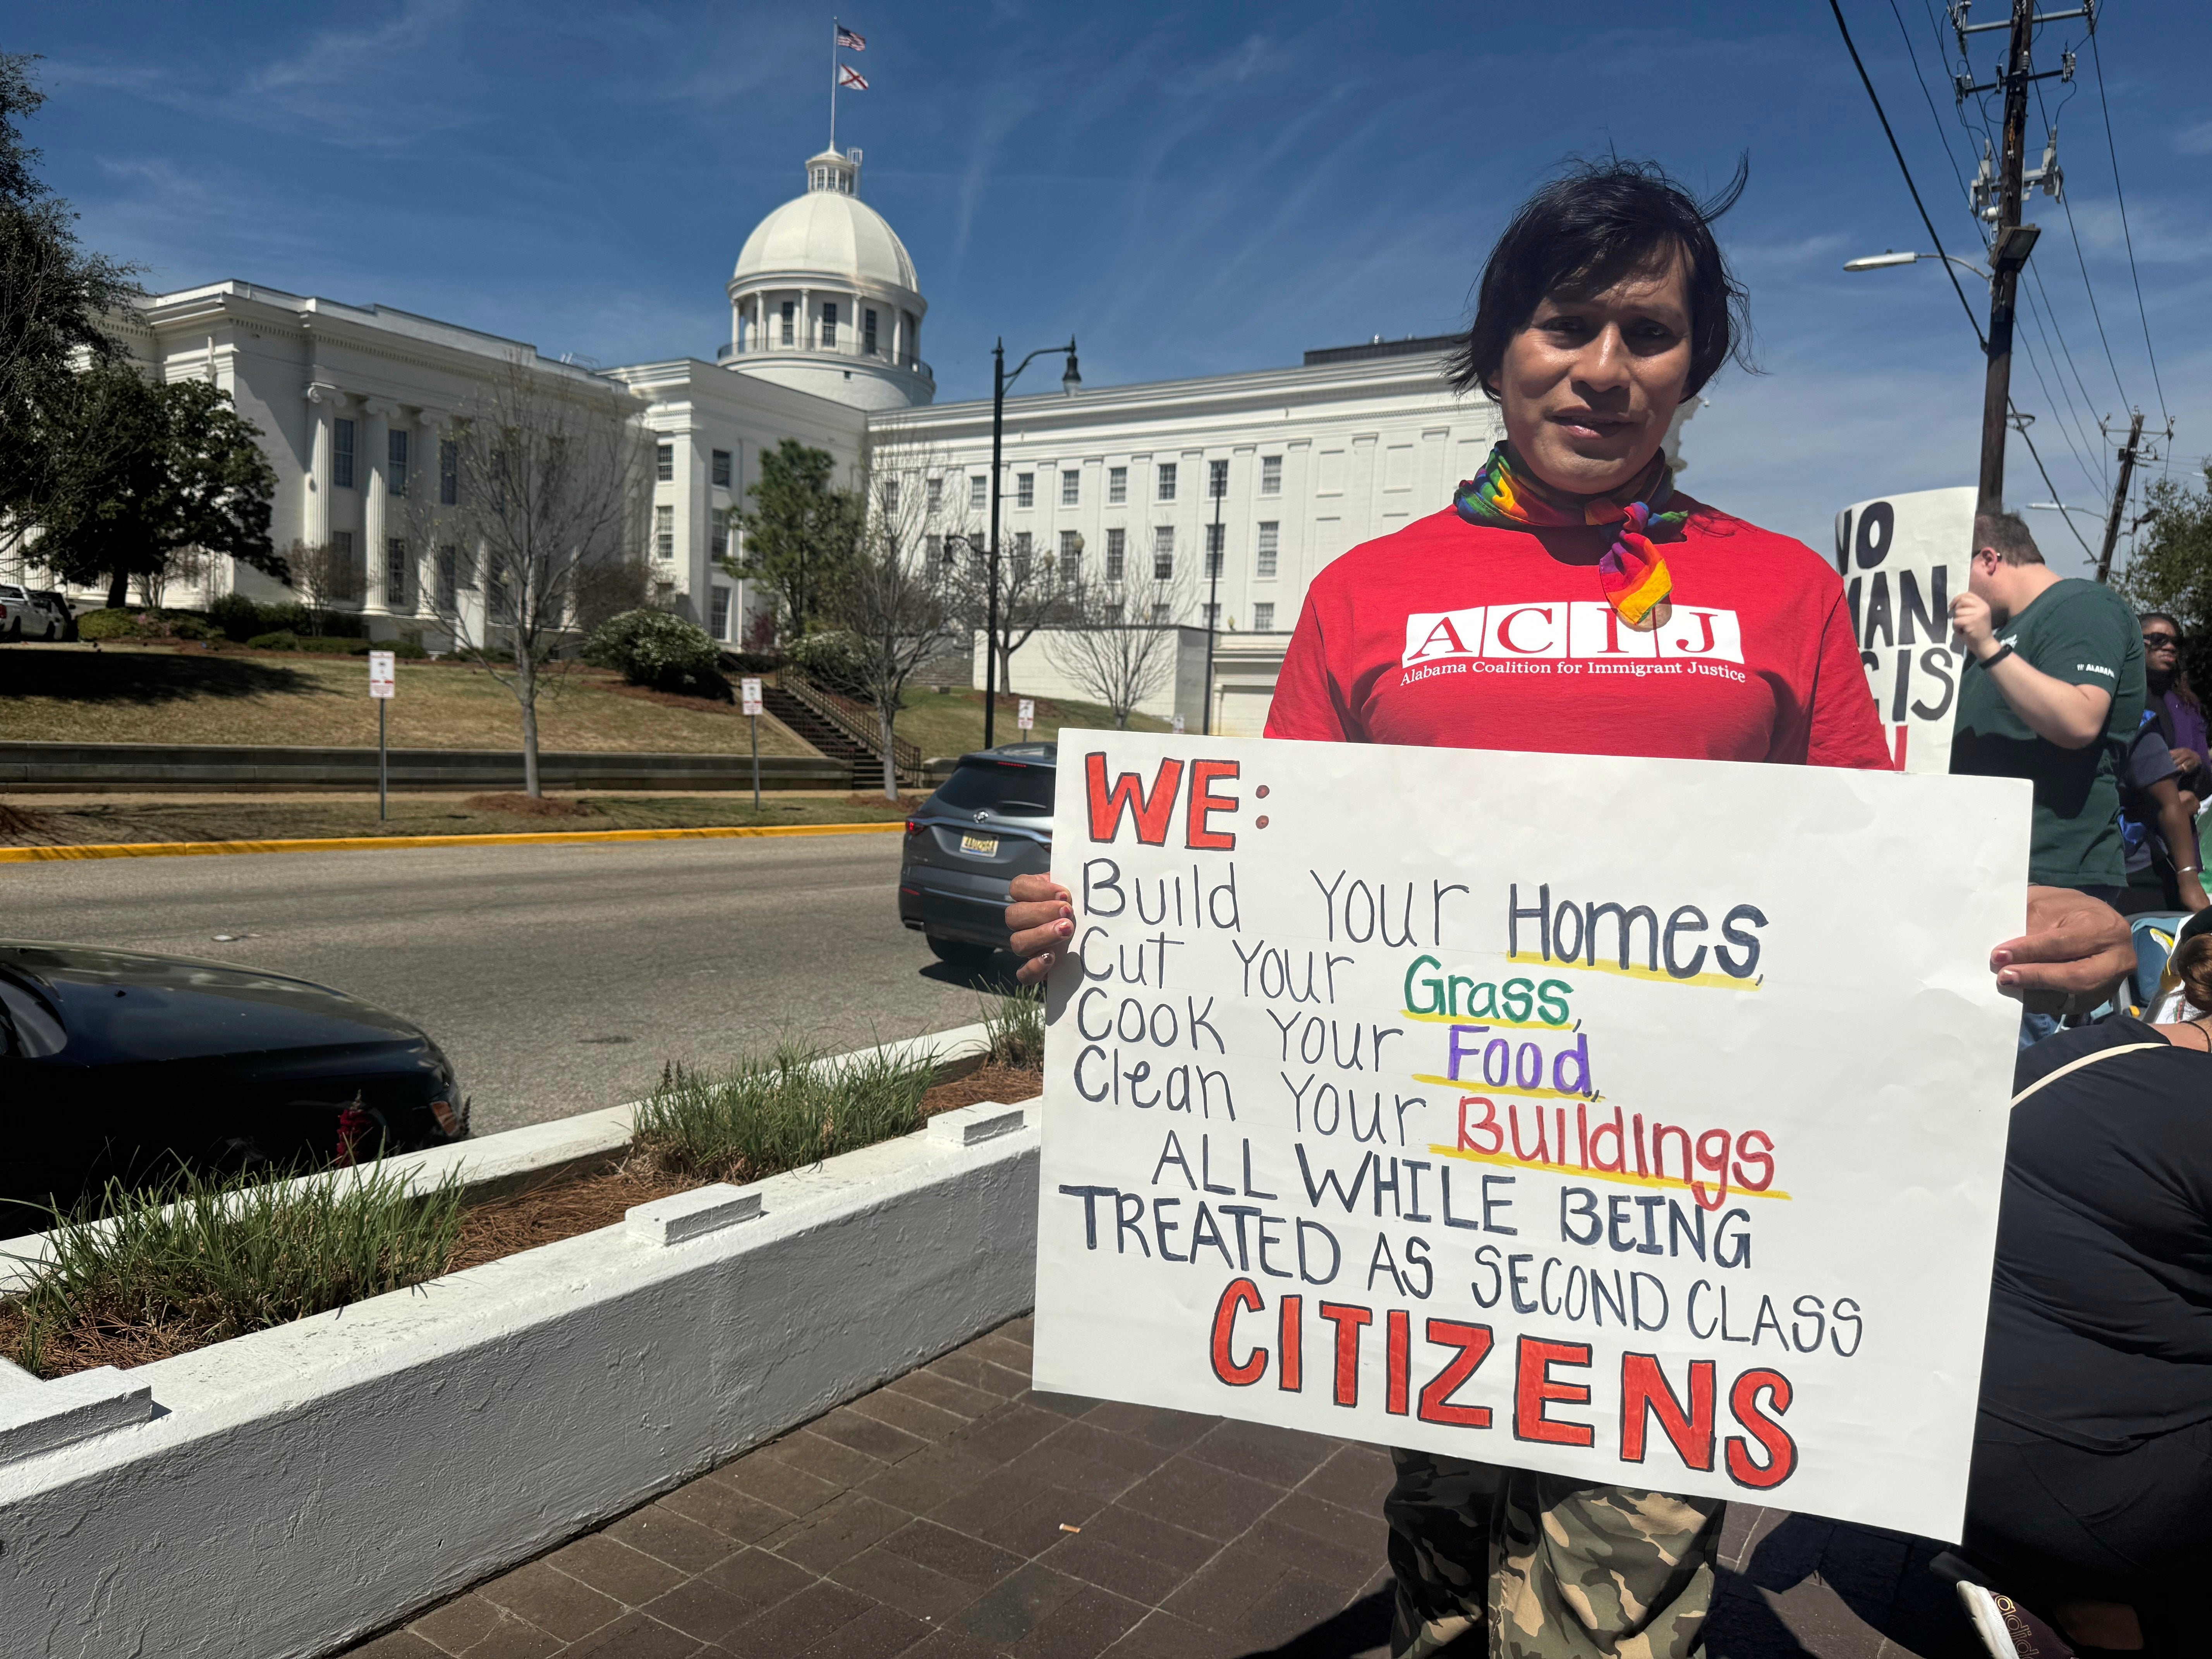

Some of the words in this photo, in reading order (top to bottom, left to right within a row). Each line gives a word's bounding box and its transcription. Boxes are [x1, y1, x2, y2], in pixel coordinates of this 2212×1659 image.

[1400, 663, 1467, 686] Alabama
[1472, 661, 1551, 674] Coalition
[1557, 661, 1582, 674] for
[1587, 661, 1682, 677] Immigrant
[1687, 662, 1745, 682] Justice
[1892, 647, 1954, 722] IS
[1085, 751, 1270, 851] WE:
[1084, 858, 1240, 933] Build
[1510, 883, 1769, 986] Homes,
[1079, 926, 1185, 989] Cut
[1404, 955, 1582, 1033] Grass,
[1447, 1024, 1599, 1103] Food,
[1074, 1044, 1236, 1121] Clean
[1457, 1096, 1775, 1211] Buildings
[1151, 1130, 1278, 1200] ALL
[1294, 1143, 1518, 1236] WHILE
[1560, 1186, 1751, 1269] BEING
[1058, 1185, 1341, 1285] TREATED
[1367, 1231, 1433, 1299] AS
[1472, 1244, 1669, 1331] SECOND
[1687, 1278, 1863, 1357] CLASS
[1209, 1277, 1798, 1491] CITIZENS
[1995, 1595, 2039, 1659] adid
